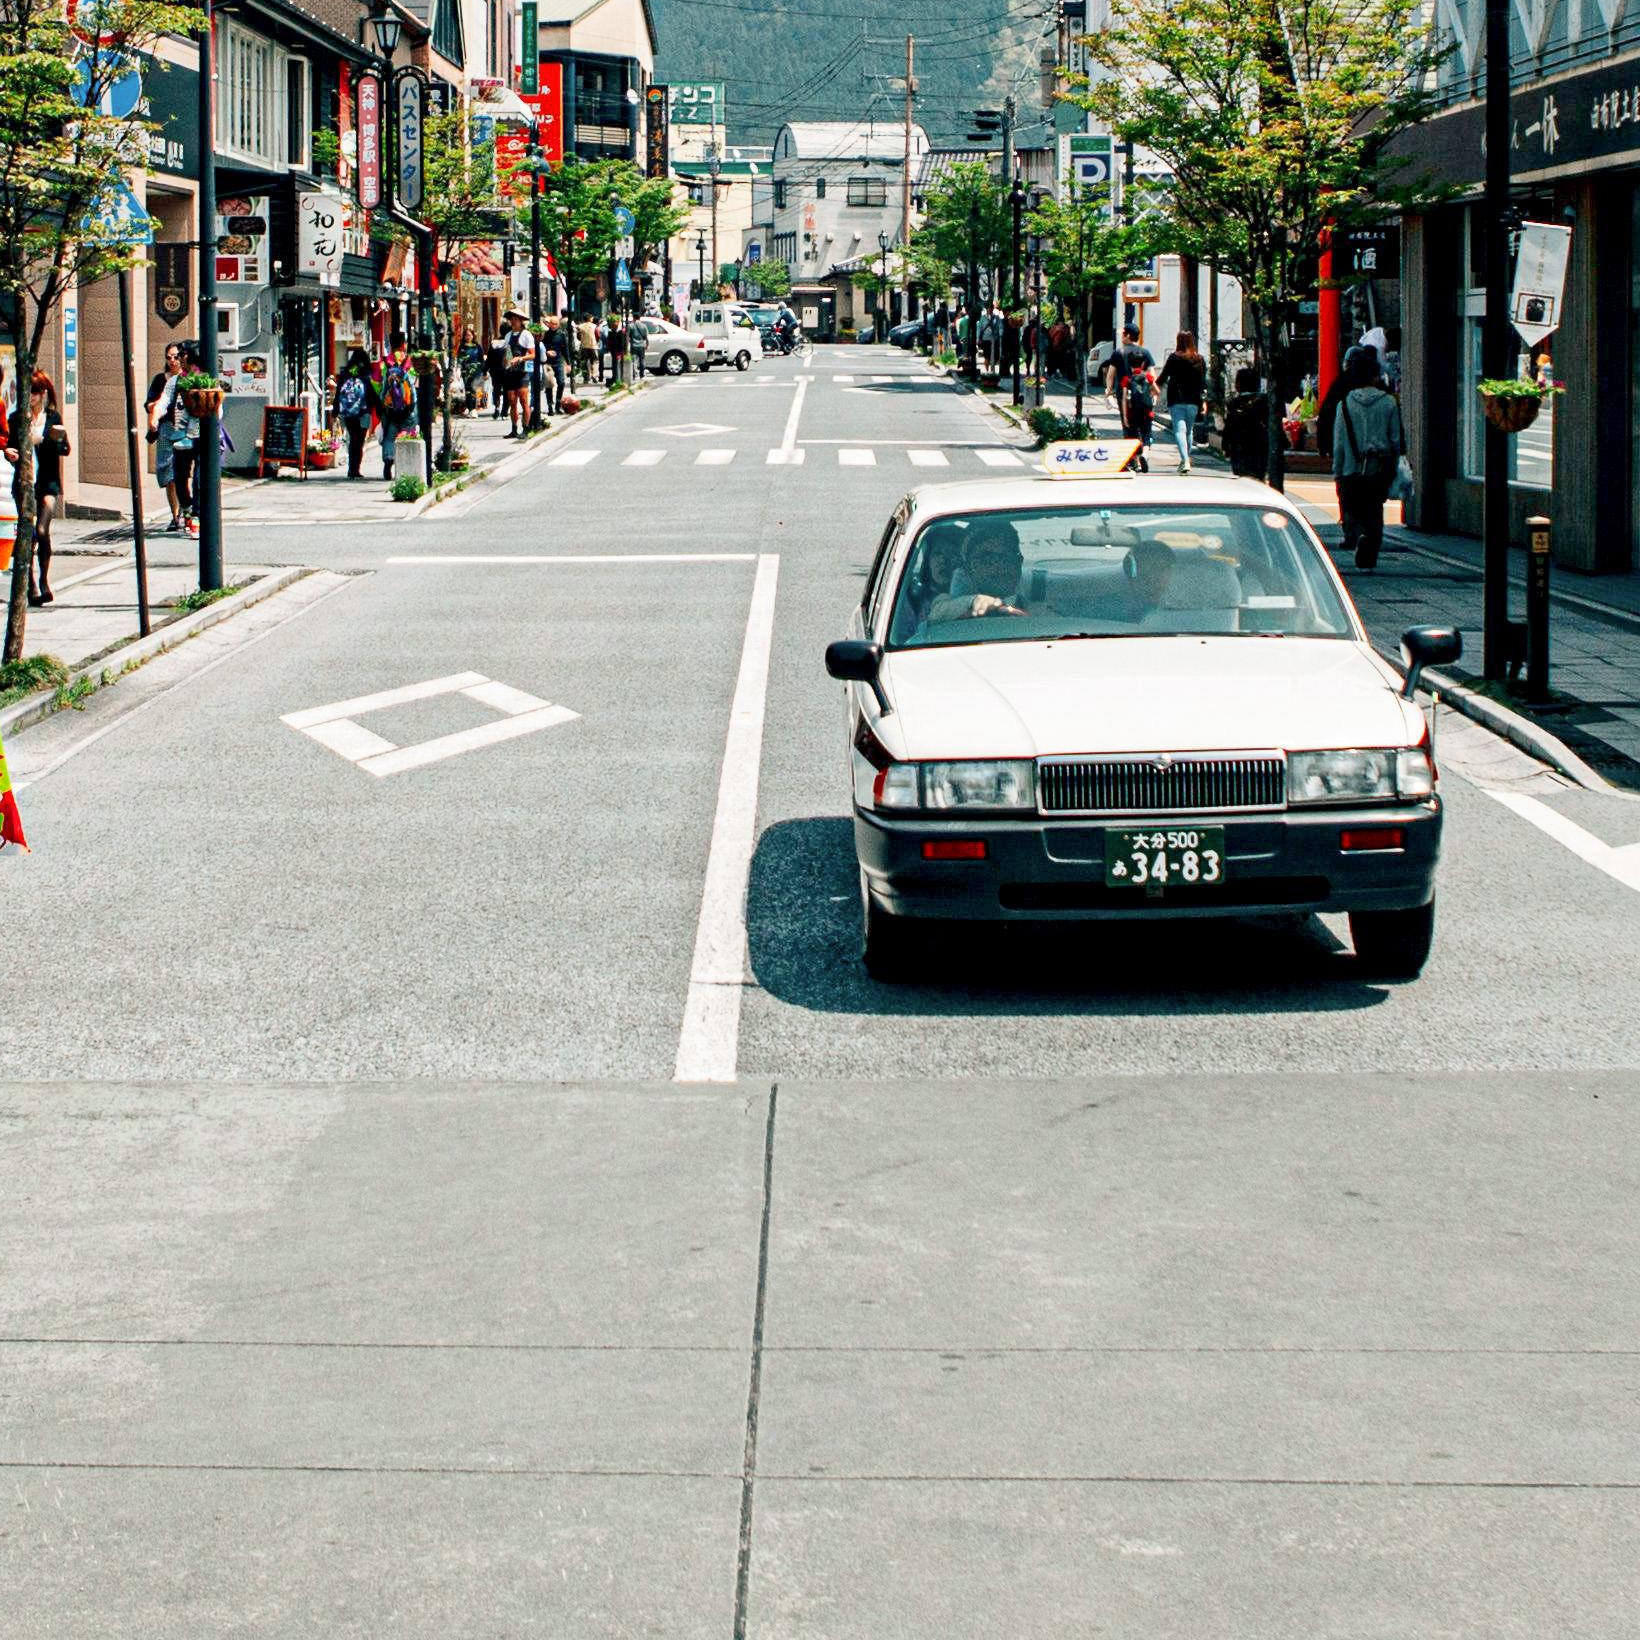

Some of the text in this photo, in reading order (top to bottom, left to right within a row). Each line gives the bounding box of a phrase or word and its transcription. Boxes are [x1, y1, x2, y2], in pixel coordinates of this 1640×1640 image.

[401, 80, 418, 201] バスセンター
[1056, 447, 1109, 462] みなと
[1112, 850, 1220, 883] あ 34-83
